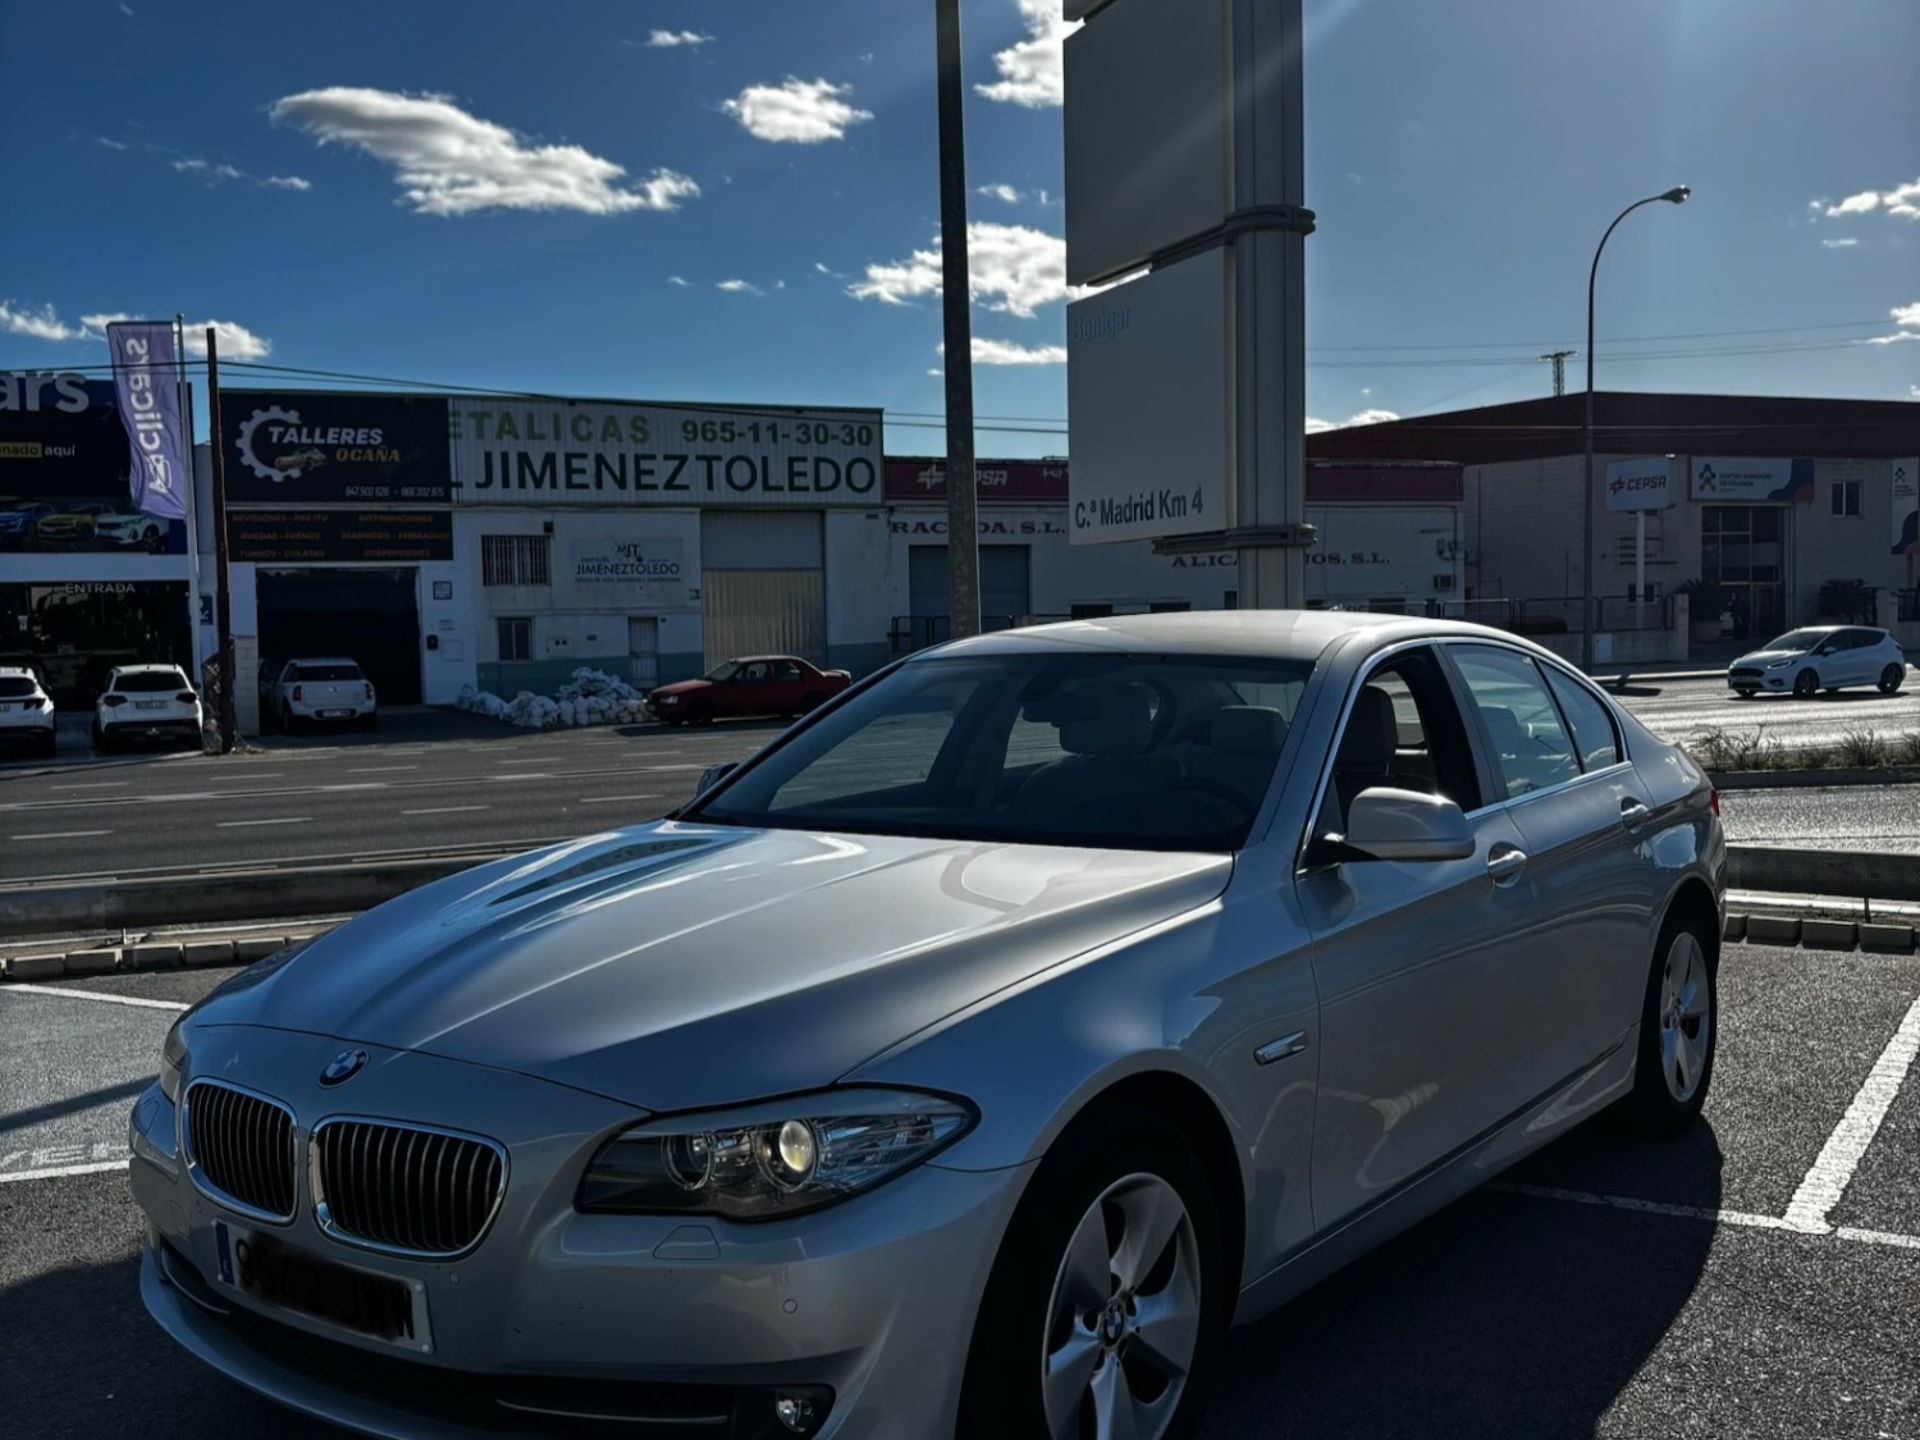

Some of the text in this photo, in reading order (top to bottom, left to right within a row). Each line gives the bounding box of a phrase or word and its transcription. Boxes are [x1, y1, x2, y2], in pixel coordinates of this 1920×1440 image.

[268, 427, 384, 445] TALLERES
[681, 419, 873, 446] 965-11-30-30
[0, 444, 76, 457] nado aquí
[334, 446, 401, 462] OCAÑA
[1626, 474, 1667, 491] CEPSA
[1100, 491, 1154, 526] Madrid
[1159, 488, 1187, 519] Km
[1192, 484, 1204, 514] 4
[1020, 521, 1066, 534] S.L.
[1351, 553, 1391, 565] S.L.
[64, 583, 137, 594] ENTRADA
